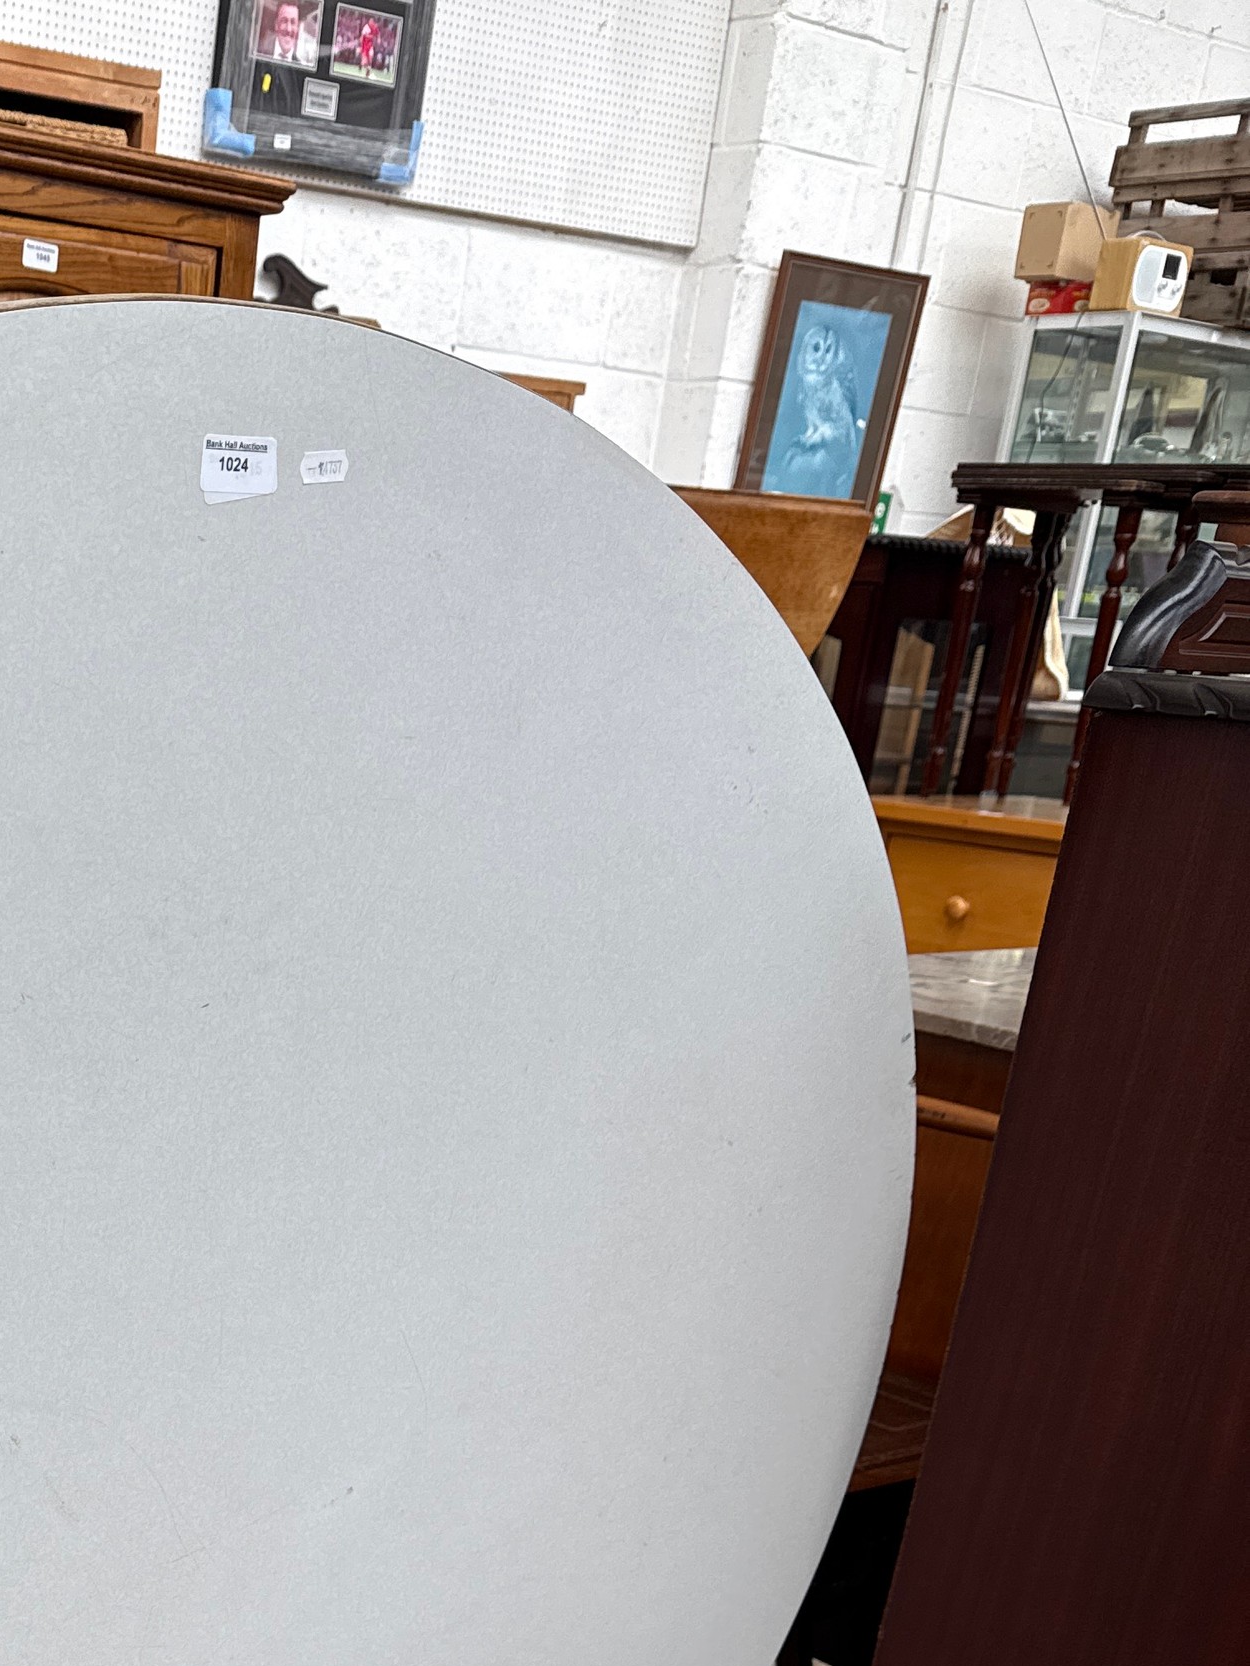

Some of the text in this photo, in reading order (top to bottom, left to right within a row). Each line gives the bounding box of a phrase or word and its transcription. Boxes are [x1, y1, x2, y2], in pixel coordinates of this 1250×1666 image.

[206, 439, 268, 451] Bank Hall Auctions
[219, 456, 249, 473] 1024
